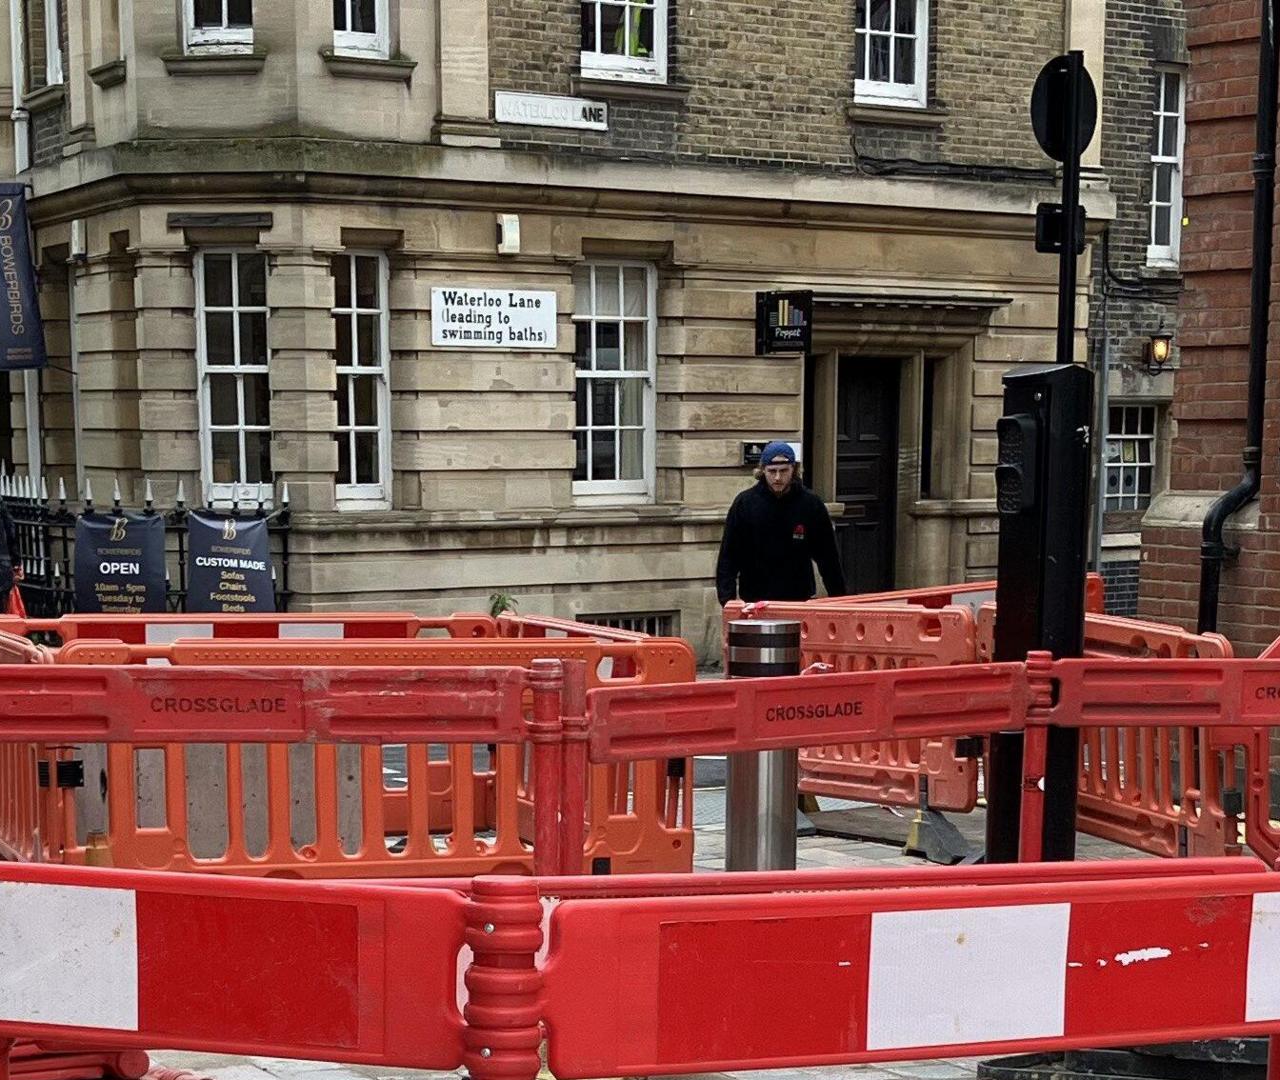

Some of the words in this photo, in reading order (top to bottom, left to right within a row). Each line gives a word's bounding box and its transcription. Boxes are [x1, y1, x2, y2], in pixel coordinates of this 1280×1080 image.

[572, 105, 604, 122] LANE
[0, 235, 25, 336] BOWERBIRDS
[442, 291, 502, 307] Waterloo
[508, 293, 541, 308] Lane
[441, 308, 492, 328] (leading
[498, 311, 510, 325] to
[442, 327, 503, 344] swimming
[509, 327, 547, 343] baths)
[99, 562, 140, 575] OPEN
[195, 556, 238, 568] CUSTOM
[239, 559, 266, 571] MADE
[221, 571, 245, 581] Sofas
[219, 581, 247, 591] Chairs
[96, 593, 133, 604] Tuesday
[135, 594, 146, 603] to
[210, 592, 257, 602] Footstools
[150, 695, 288, 715] CROSSGLADE
[765, 700, 863, 723] CROSSGLADE
